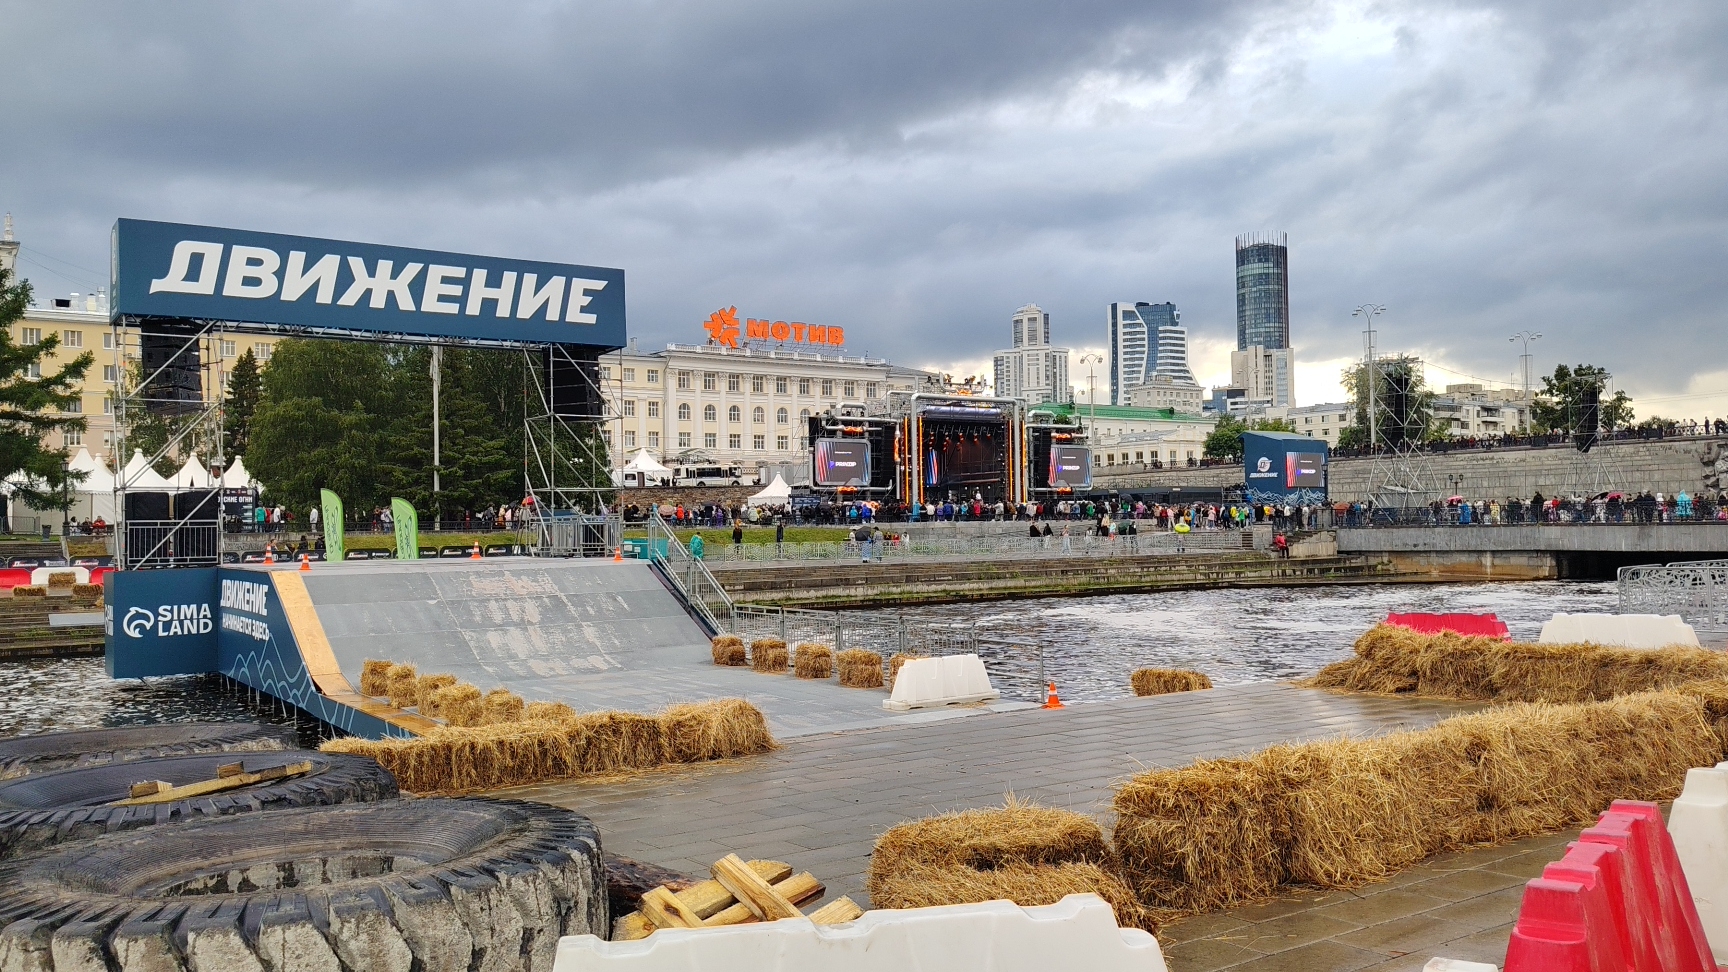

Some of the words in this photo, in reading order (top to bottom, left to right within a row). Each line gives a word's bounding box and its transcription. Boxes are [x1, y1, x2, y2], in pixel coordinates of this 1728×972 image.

[149, 239, 608, 325] ДВИЖЕНИЕ
[746, 317, 845, 346] МОТИВ
[157, 603, 212, 621] SIMA
[220, 579, 269, 616] ДВИЖЕНИЕ
[157, 618, 213, 637] LAND
[222, 612, 252, 635] НАЧИНАЕТСЯ
[252, 619, 270, 641] ЗДЕСЬ
